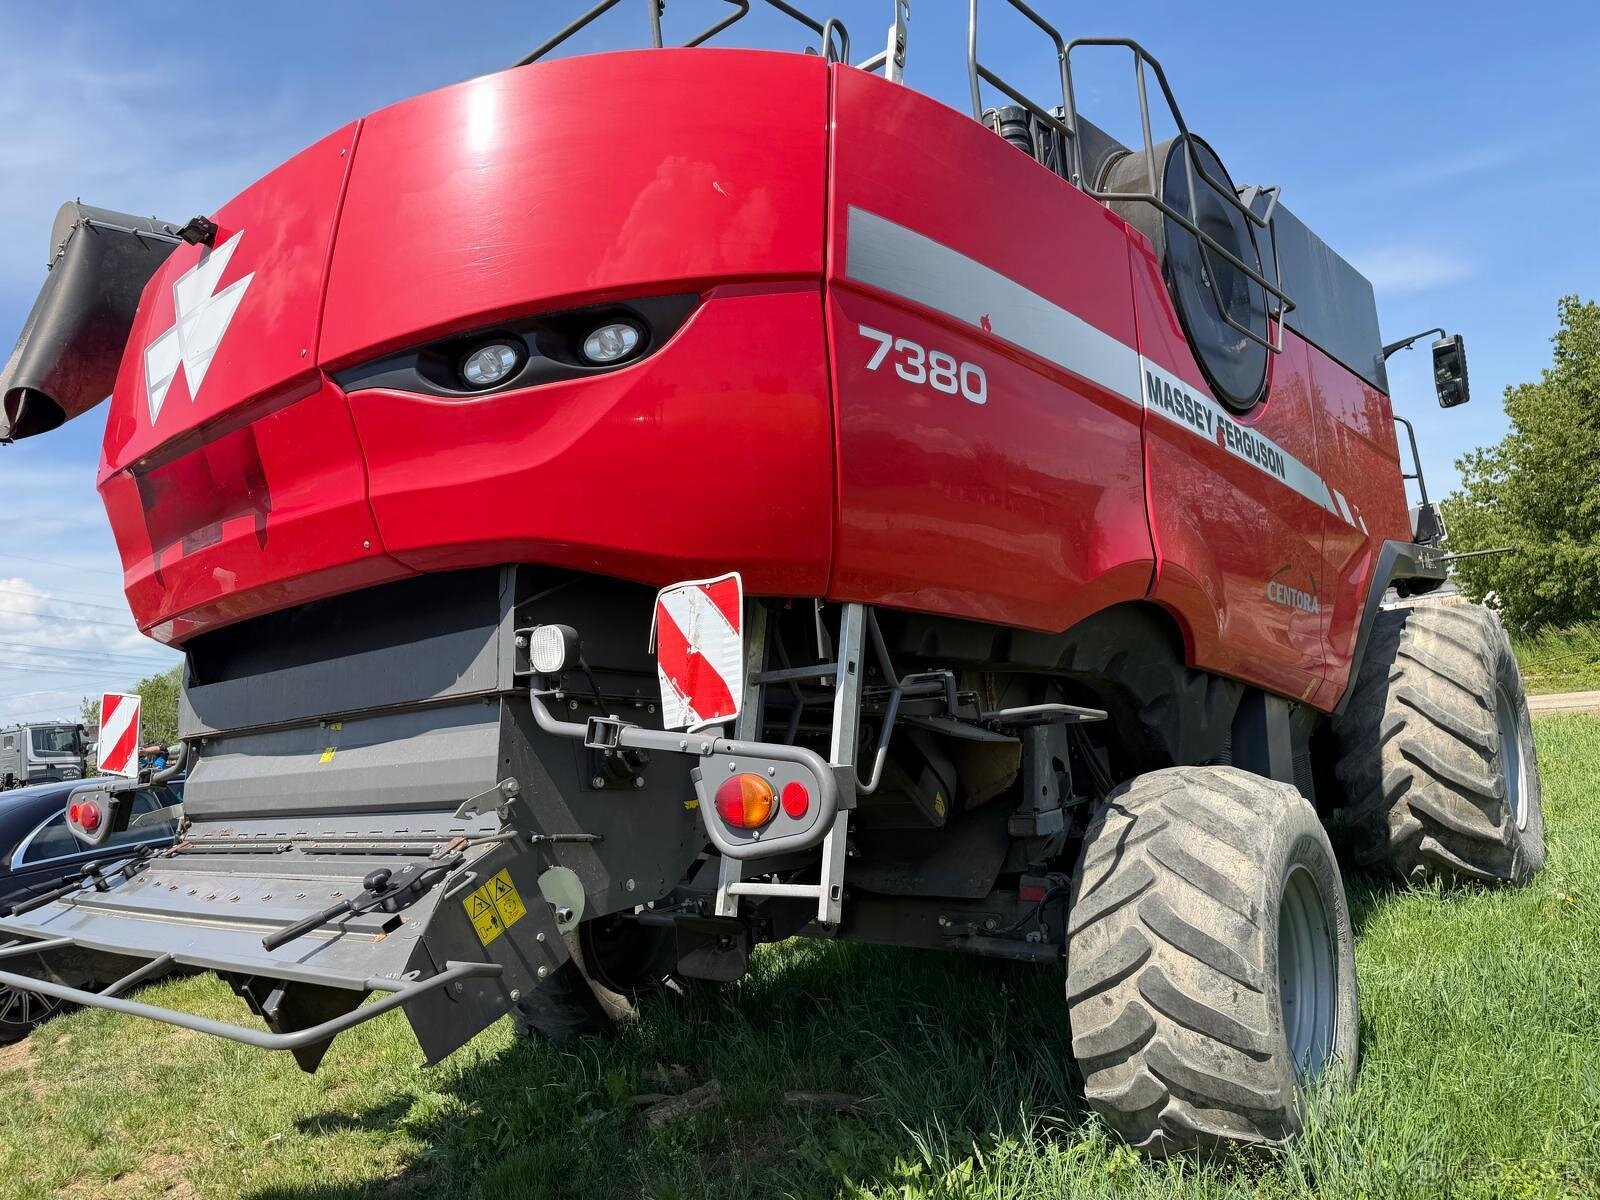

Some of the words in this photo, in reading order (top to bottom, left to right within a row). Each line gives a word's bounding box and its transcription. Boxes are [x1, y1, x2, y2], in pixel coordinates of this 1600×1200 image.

[858, 323, 988, 405] 7380
[1146, 370, 1213, 436] MASSEY
[1266, 580, 1320, 615] CENTORA
